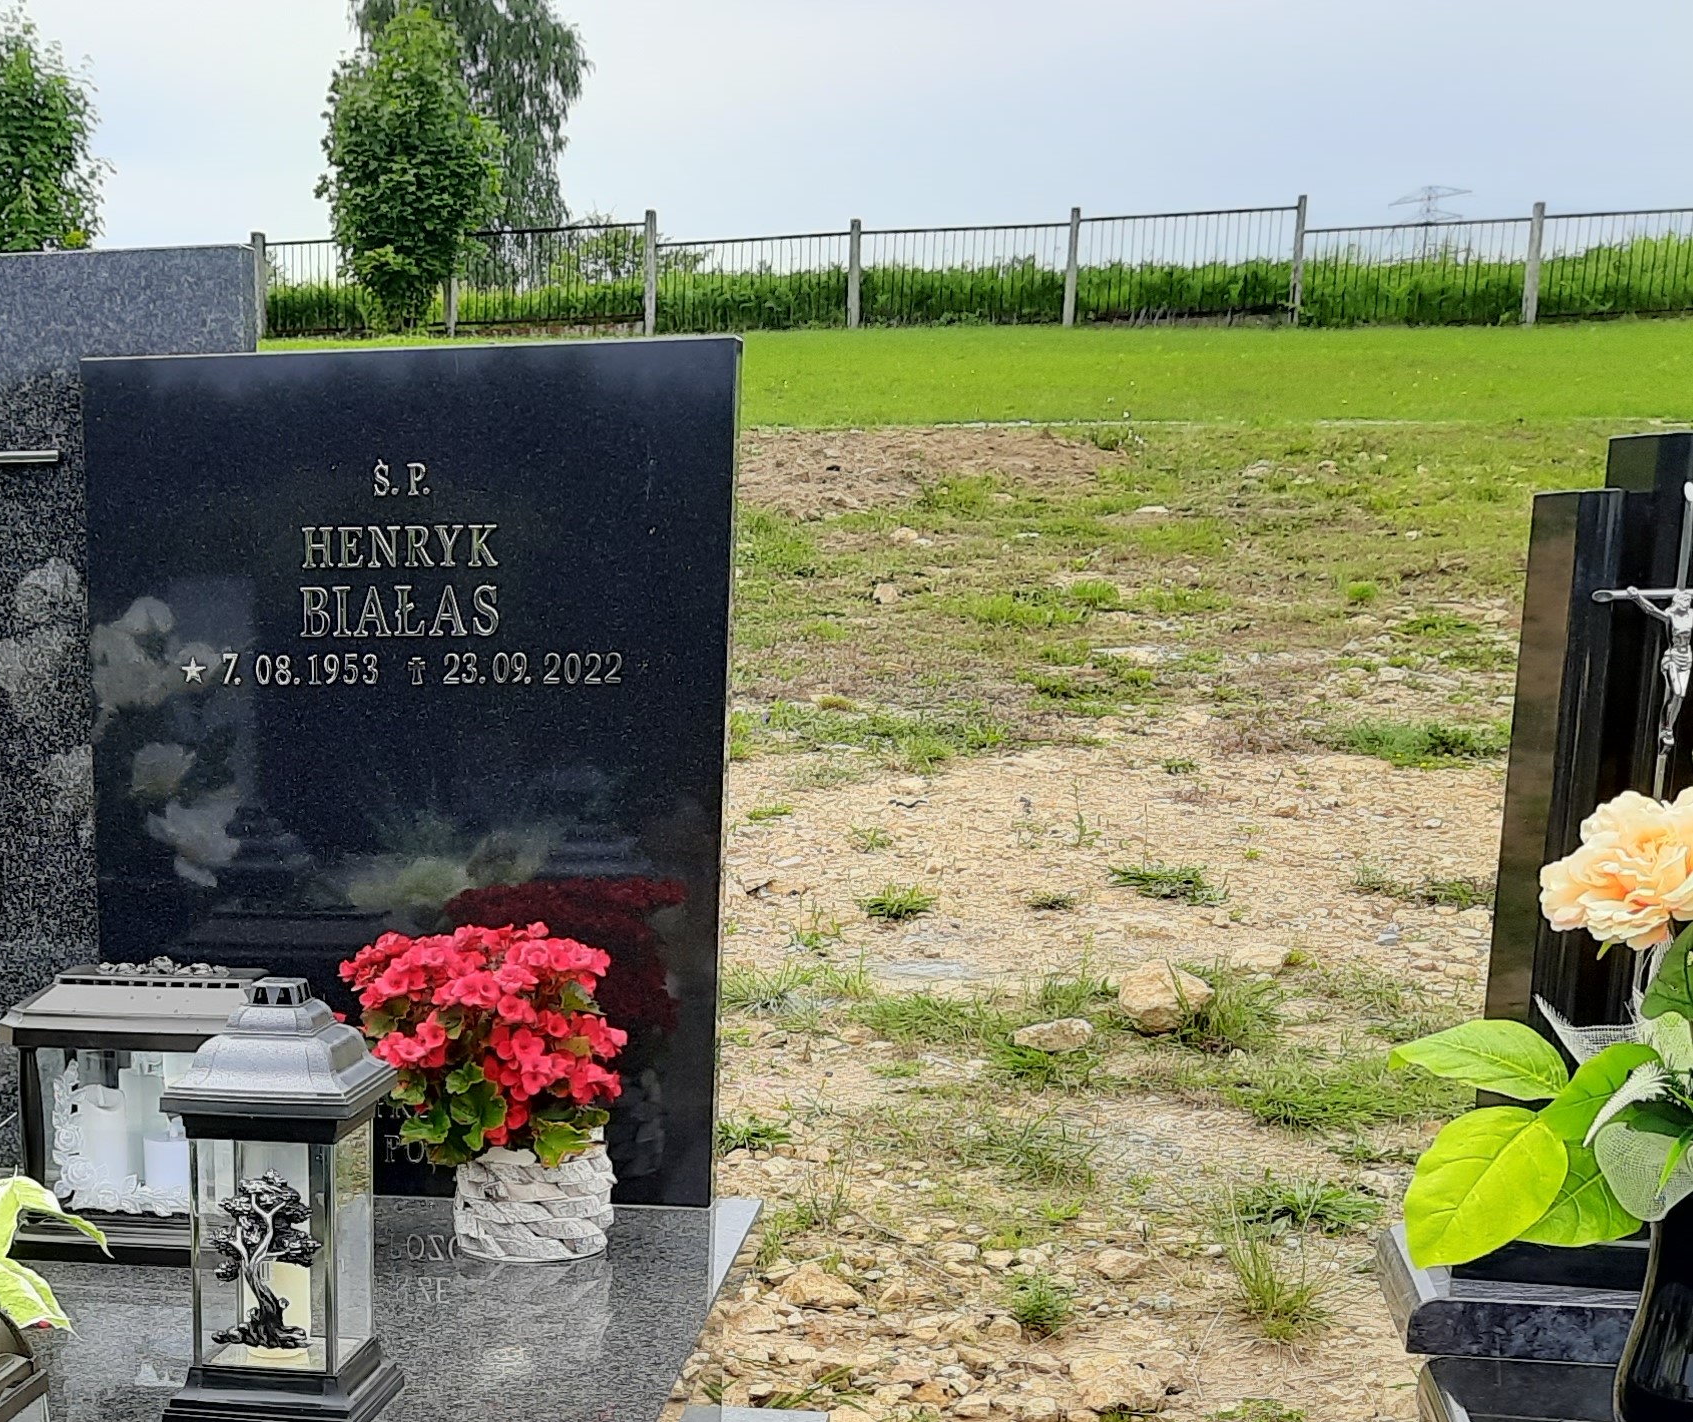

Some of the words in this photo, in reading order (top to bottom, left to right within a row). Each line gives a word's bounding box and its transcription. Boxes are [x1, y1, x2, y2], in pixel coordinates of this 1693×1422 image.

[406, 462, 431, 496] P.
[301, 523, 499, 569] HENRYK
[300, 584, 499, 638] BIAŁAS
